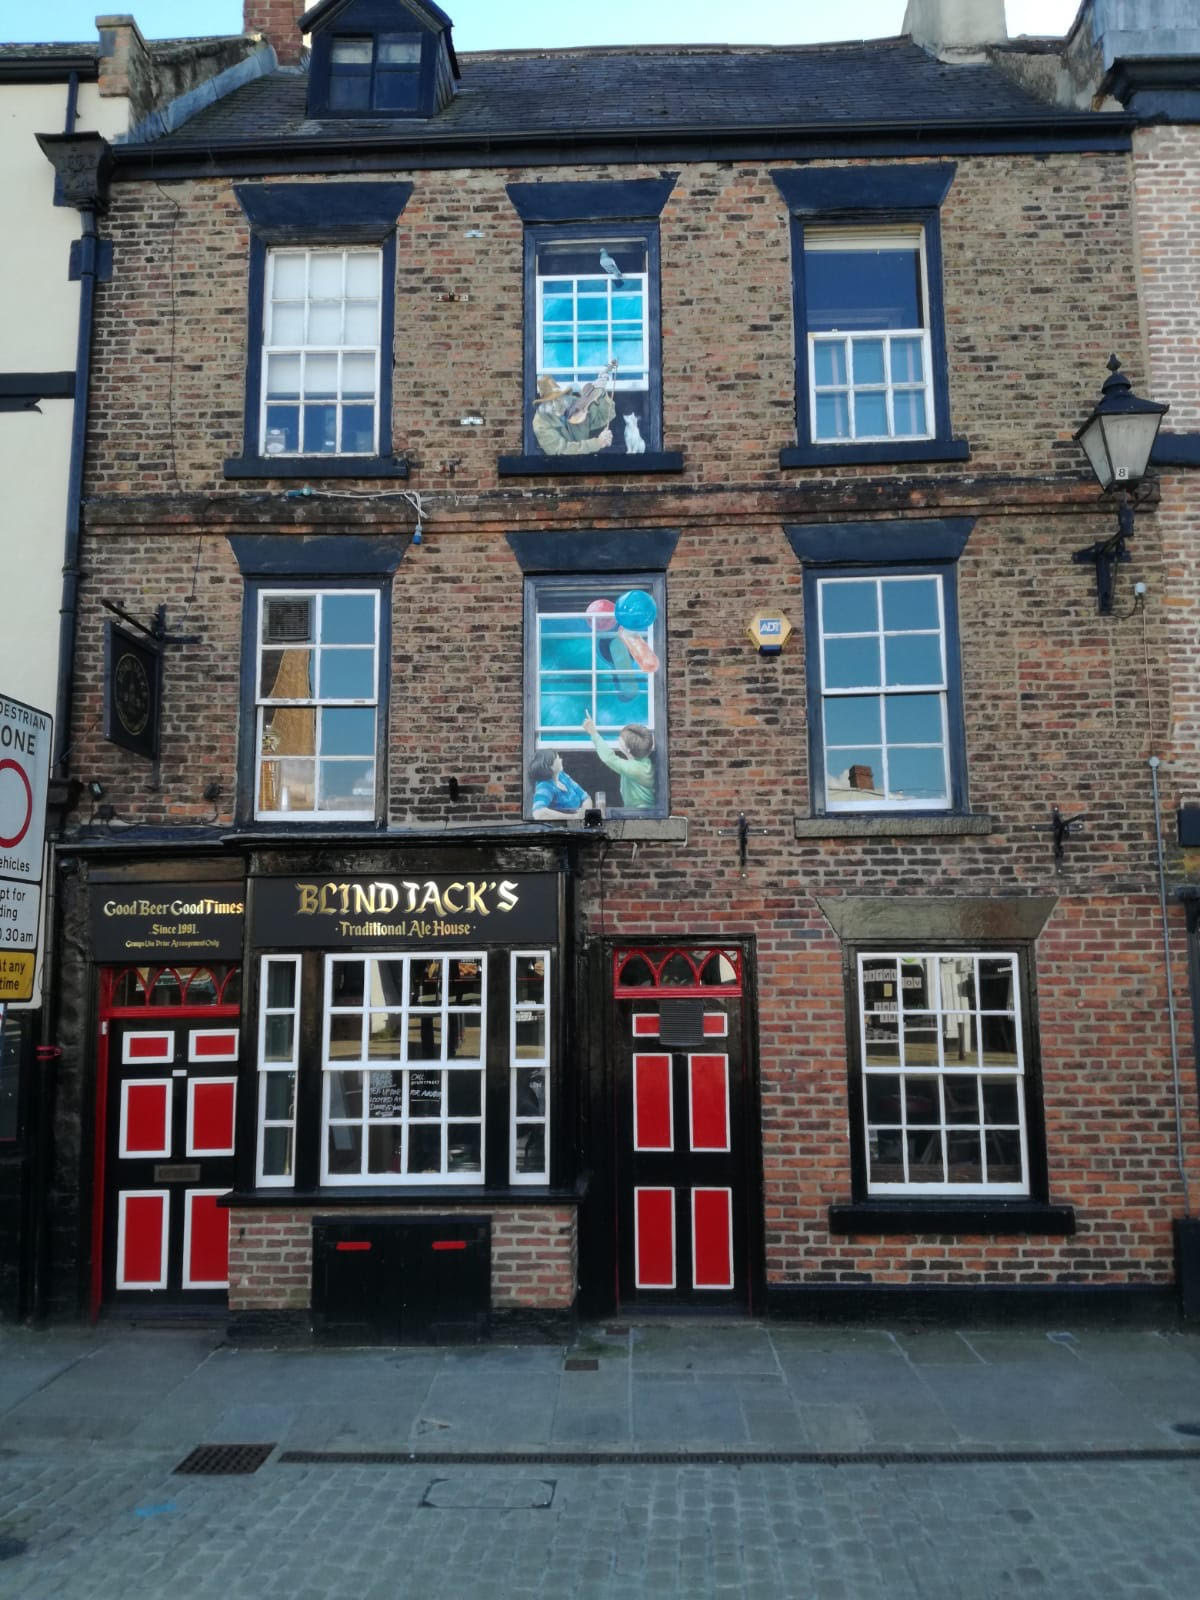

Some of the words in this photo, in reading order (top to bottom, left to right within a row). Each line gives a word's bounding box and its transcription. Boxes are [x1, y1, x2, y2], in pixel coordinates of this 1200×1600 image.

[1118, 468, 1126, 477] 8
[760, 621, 780, 632] ADT
[12, 888, 26, 902] for
[295, 881, 399, 916] BLIND
[402, 880, 519, 917] JACK'S
[103, 900, 137, 917] Good
[137, 899, 170, 916] Beer
[170, 899, 204, 916] Good
[204, 898, 245, 916] Times
[151, 923, 177, 935] Since
[339, 920, 406, 937] Traditional
[408, 919, 431, 938] Ale
[433, 920, 471, 936] House
[9, 962, 26, 975] any
[0, 976, 20, 990] time
